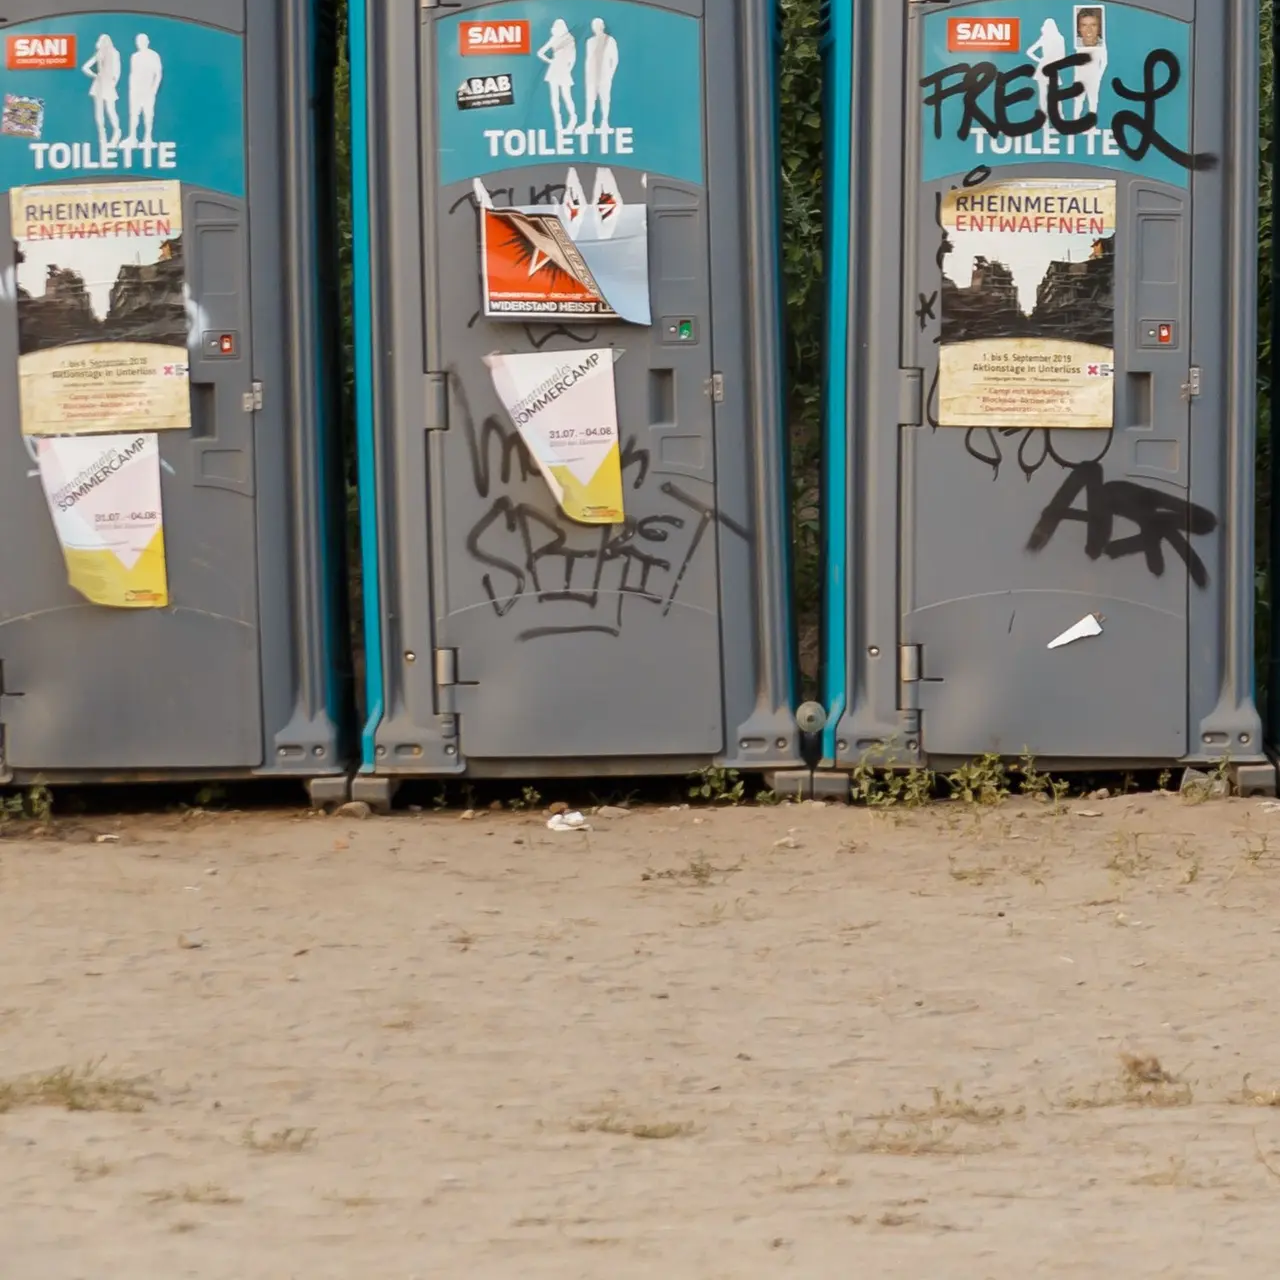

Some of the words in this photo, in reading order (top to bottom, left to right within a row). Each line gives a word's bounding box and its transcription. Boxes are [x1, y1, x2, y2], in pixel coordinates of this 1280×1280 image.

[468, 26, 522, 44] SANI
[956, 22, 1011, 40] SANI
[14, 38, 68, 56] SANI
[458, 75, 511, 96] ABAB
[919, 51, 1099, 141] FREE
[483, 127, 634, 157] TOILETTE
[29, 142, 177, 169] TOILETTE
[26, 199, 170, 221] RHEINMETALL
[956, 195, 1104, 214] RHEINMETALL
[26, 219, 171, 242] ENTWAFFNEN
[956, 215, 1104, 235] ENTWAFFNEN
[490, 301, 557, 312] WIDERSTAND
[559, 302, 596, 312] HEISST
[1012, 354, 1052, 364] September
[972, 364, 1026, 375] Aktionstage
[58, 437, 145, 512] SOMMERCAMP
